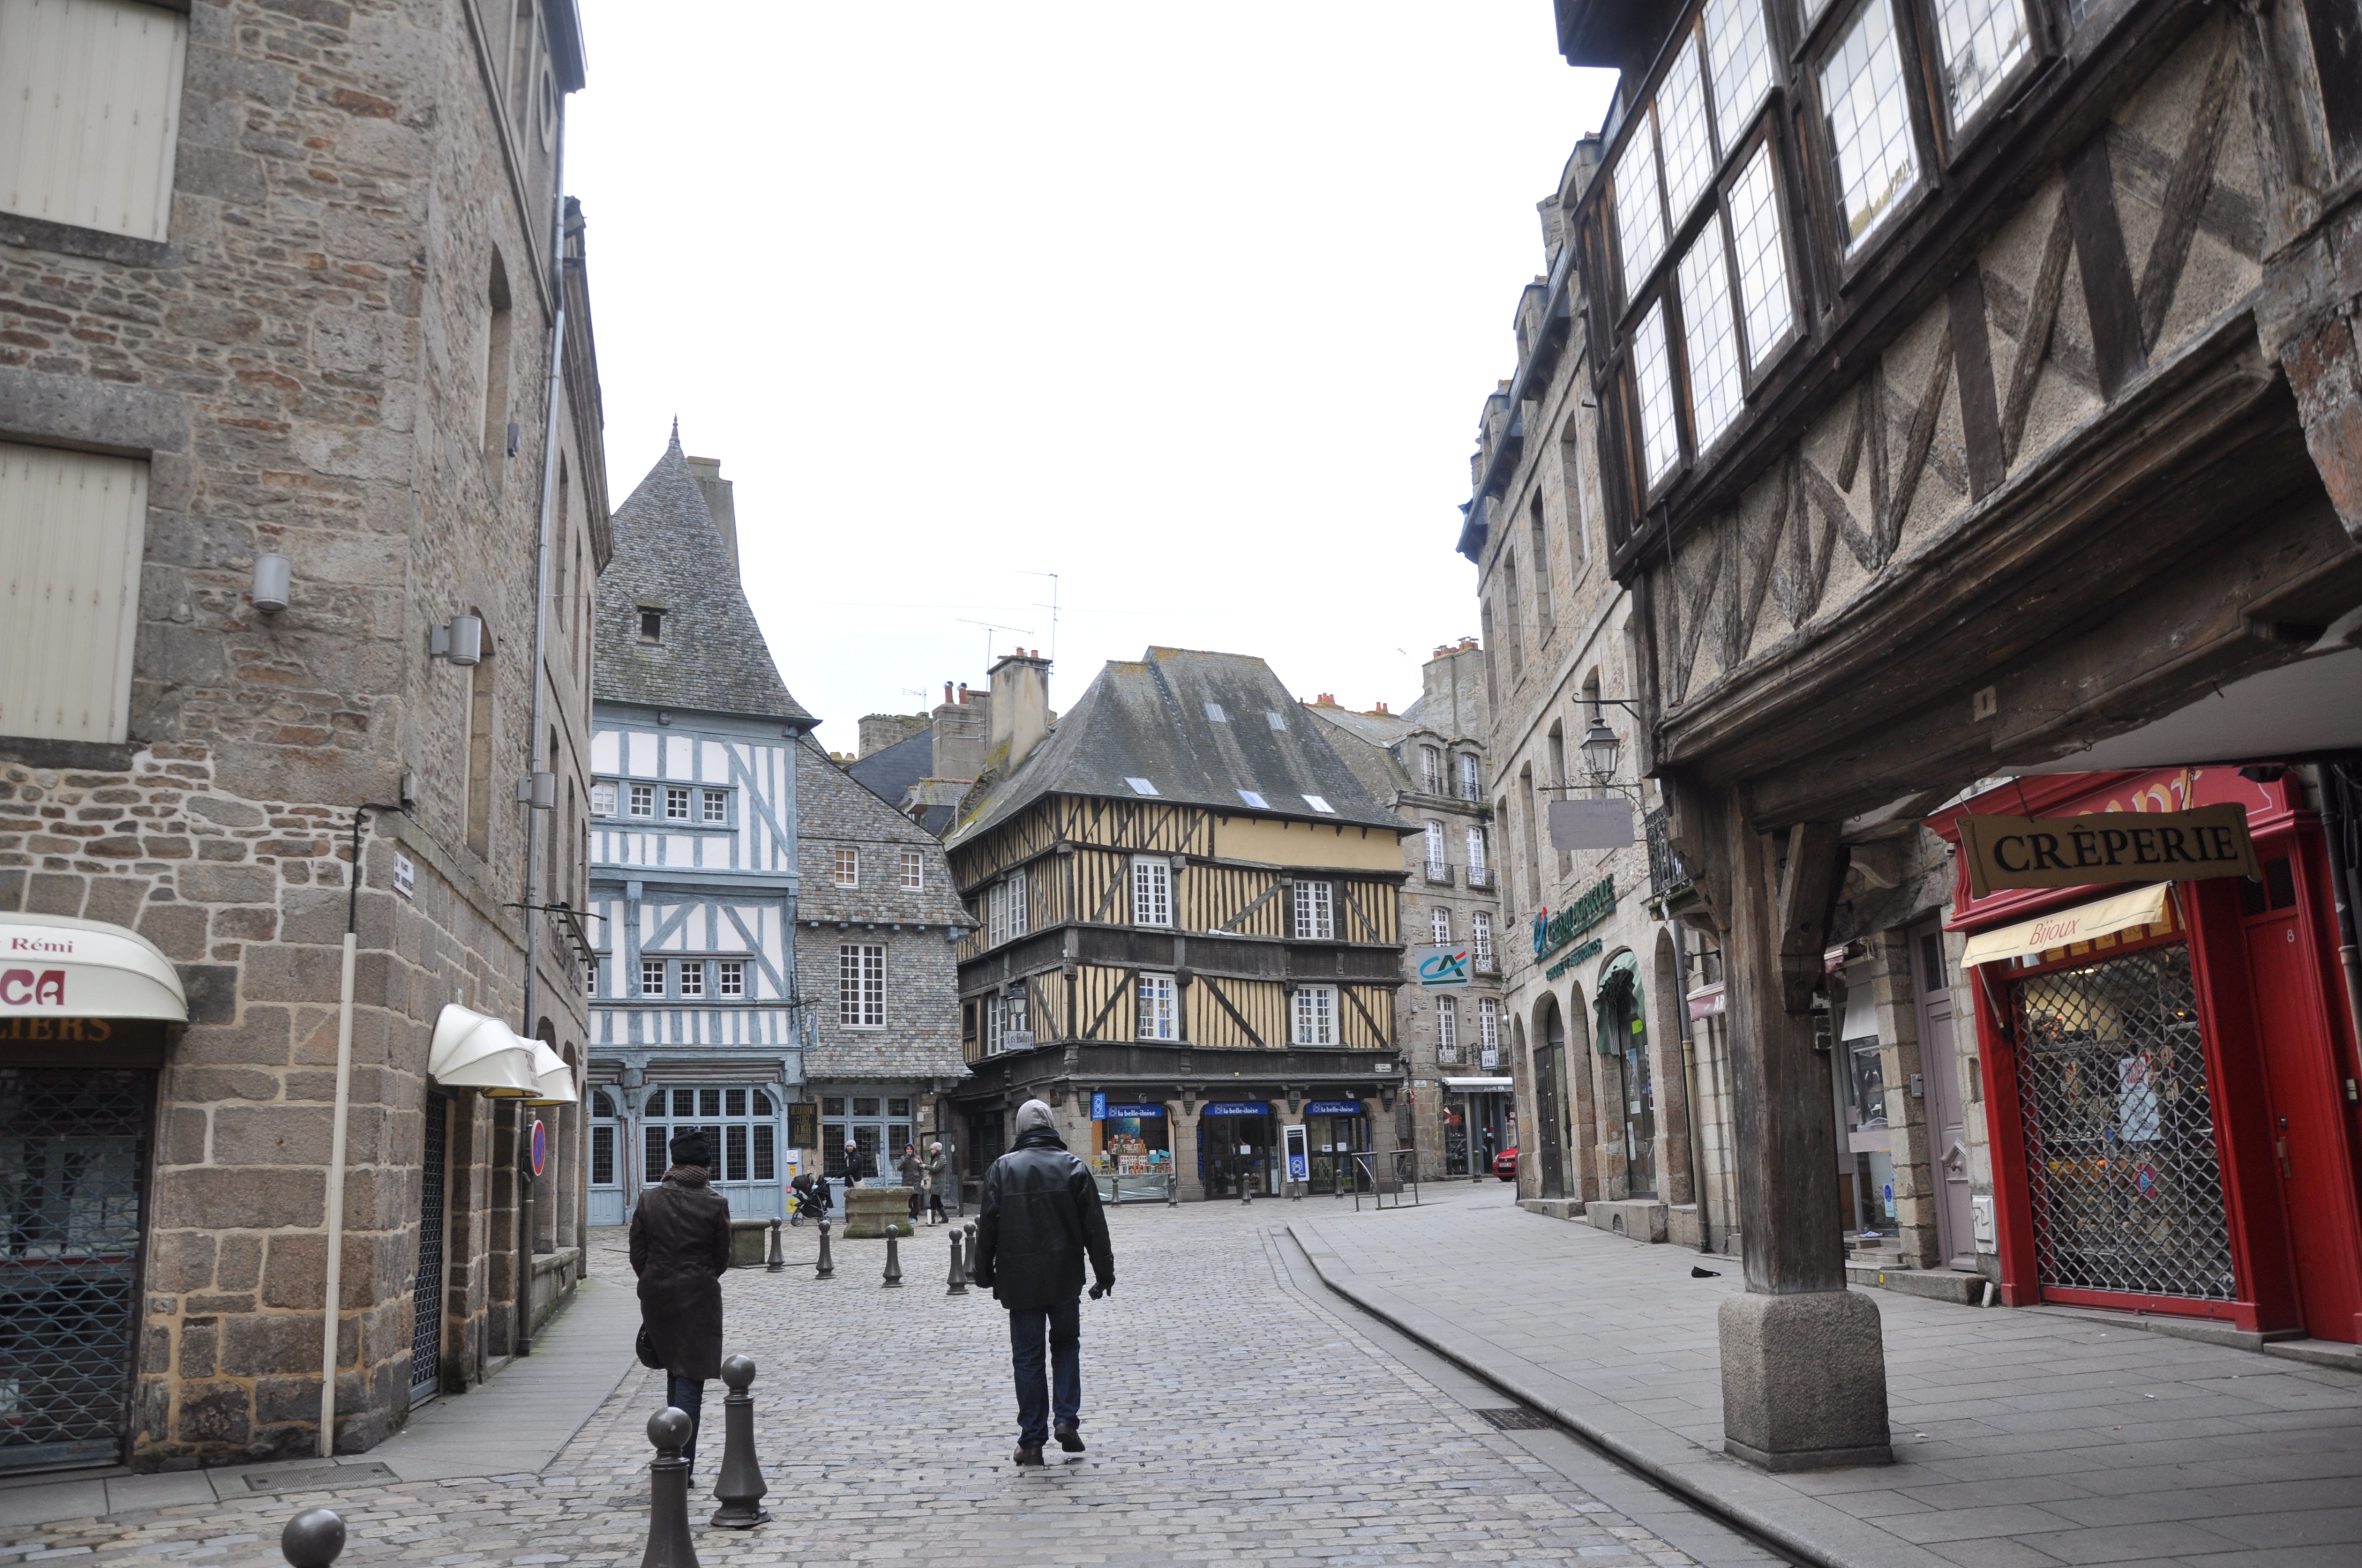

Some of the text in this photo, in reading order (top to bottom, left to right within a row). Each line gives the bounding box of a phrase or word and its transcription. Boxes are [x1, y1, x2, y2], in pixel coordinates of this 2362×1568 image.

[1993, 824, 2238, 872] CRÊPERIE
[12, 937, 73, 953] Rémi
[2028, 918, 2081, 949] Bijoux
[2286, 929, 2295, 943] 8
